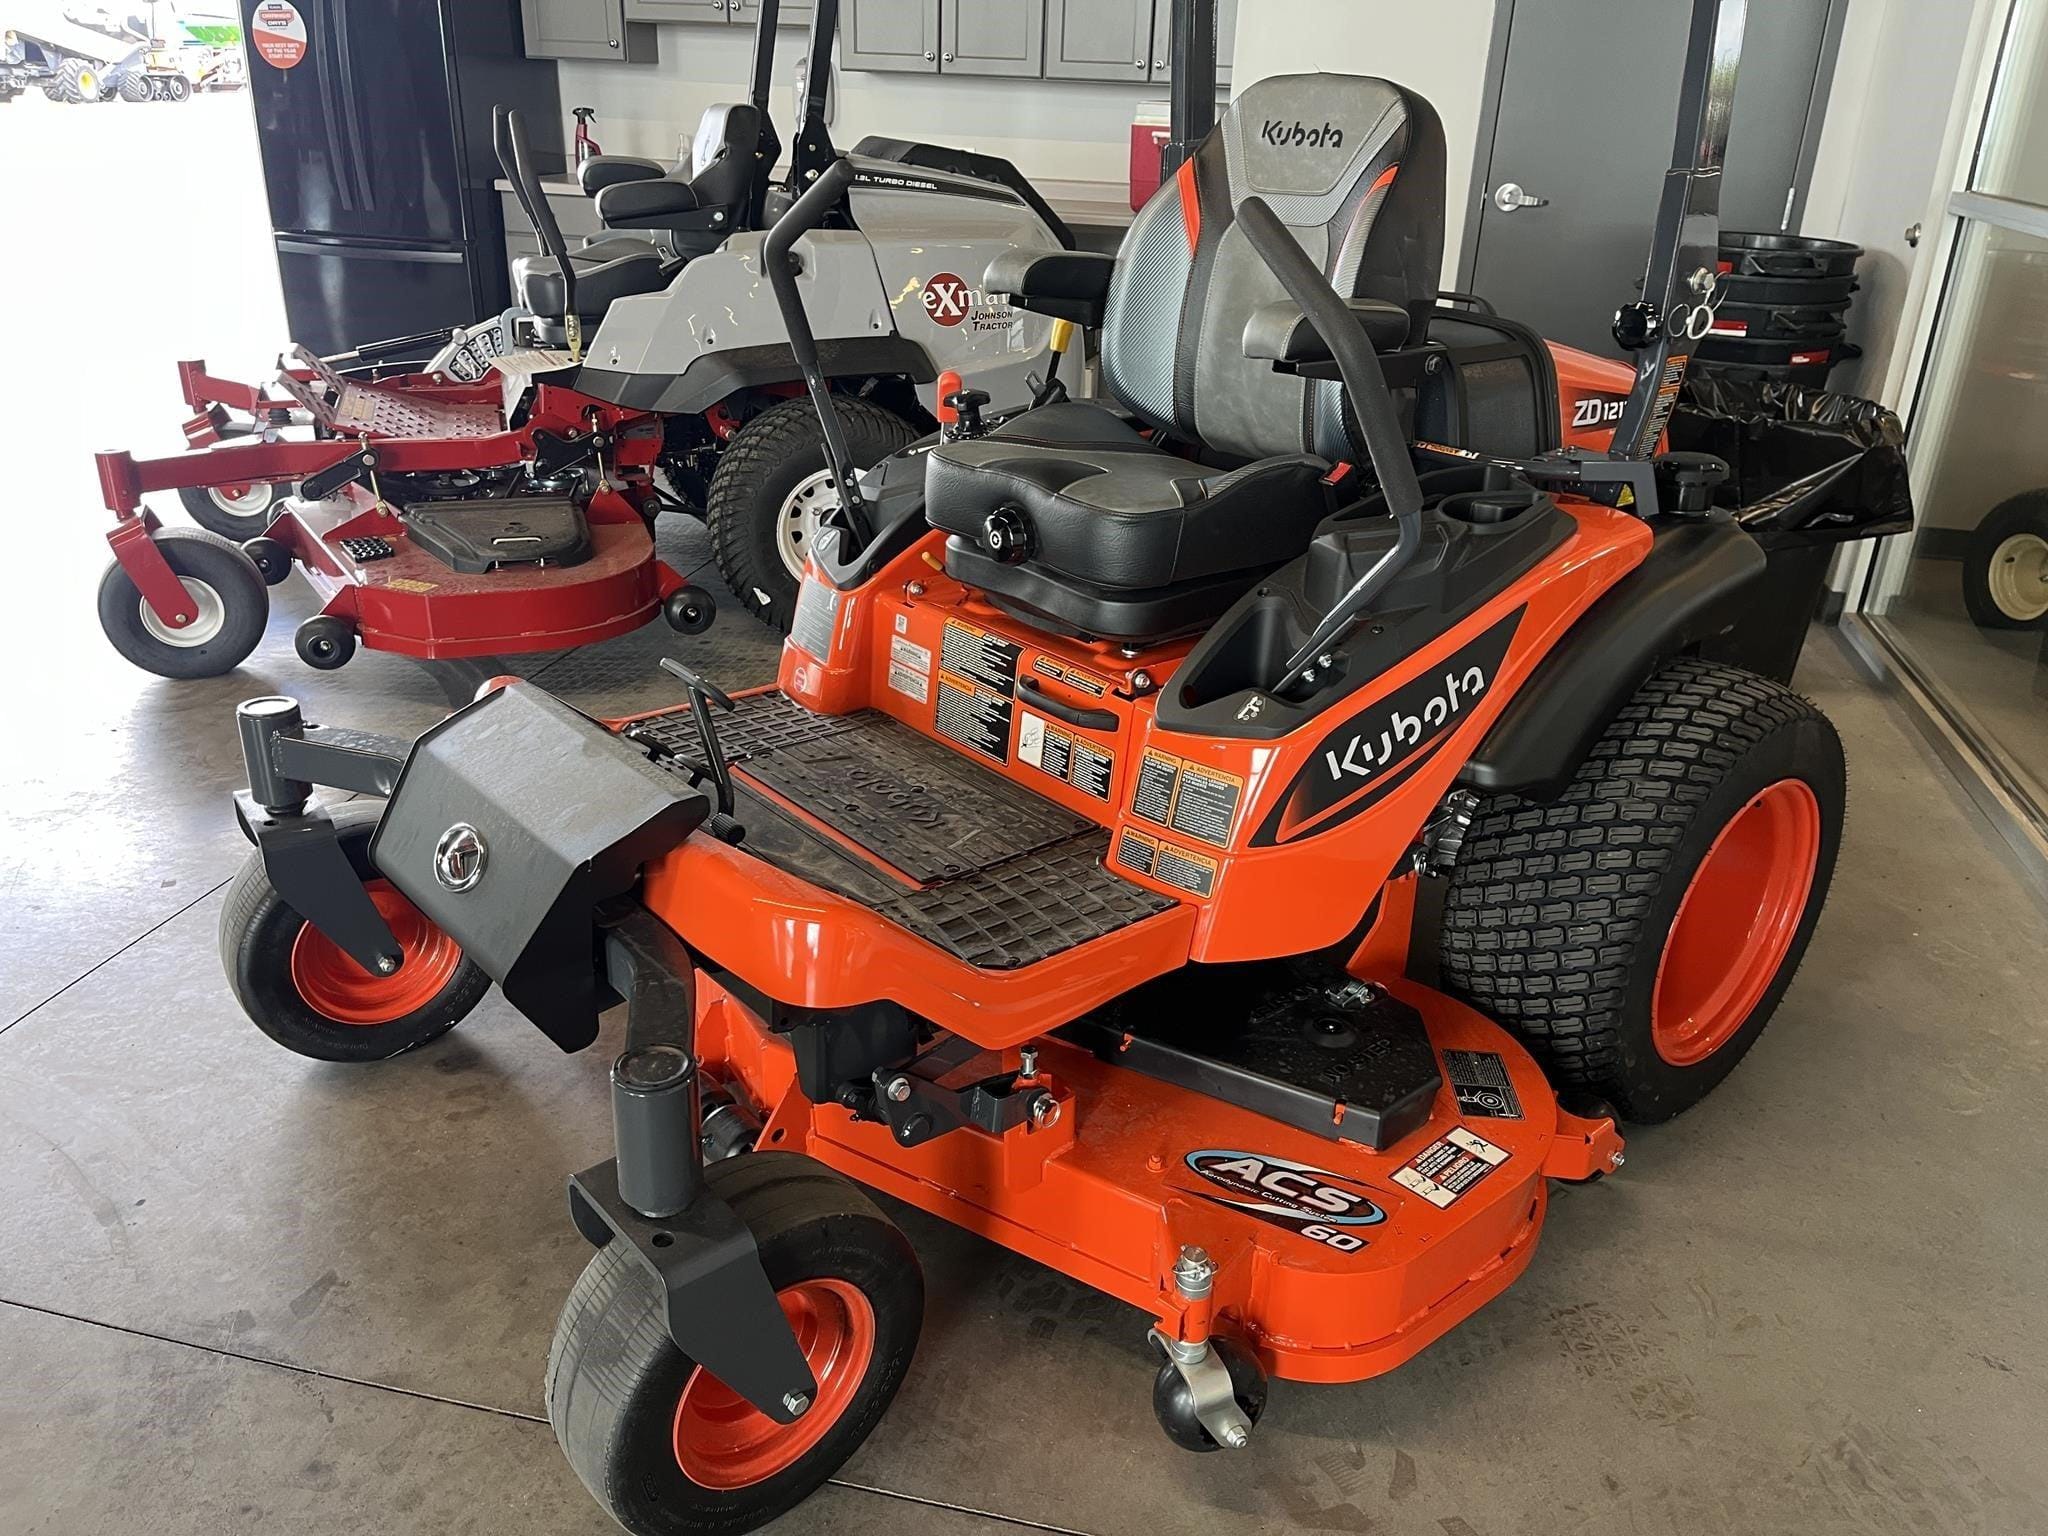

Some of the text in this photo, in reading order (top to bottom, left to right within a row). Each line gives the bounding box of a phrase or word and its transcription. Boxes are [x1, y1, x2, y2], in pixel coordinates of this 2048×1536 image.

[1262, 120, 1343, 148] Kubota
[874, 176, 904, 185] TURBO
[906, 180, 938, 190] DIESEL
[922, 282, 1010, 318] eXmar
[971, 311, 1012, 320] JOHNSON
[972, 321, 1013, 331] TRACTOR
[1326, 666, 1484, 781] Kubota
[1196, 766, 1235, 782] ADVERTENCIA
[1170, 846, 1212, 866] ADVERTENCIA
[1419, 1140, 1444, 1160] DANGER
[1444, 1156, 1470, 1178] PELIGRO
[1200, 1169, 1338, 1224] Aerodynamic Cutting System
[1208, 1158, 1362, 1214] ACS
[1301, 1224, 1363, 1250] 60
